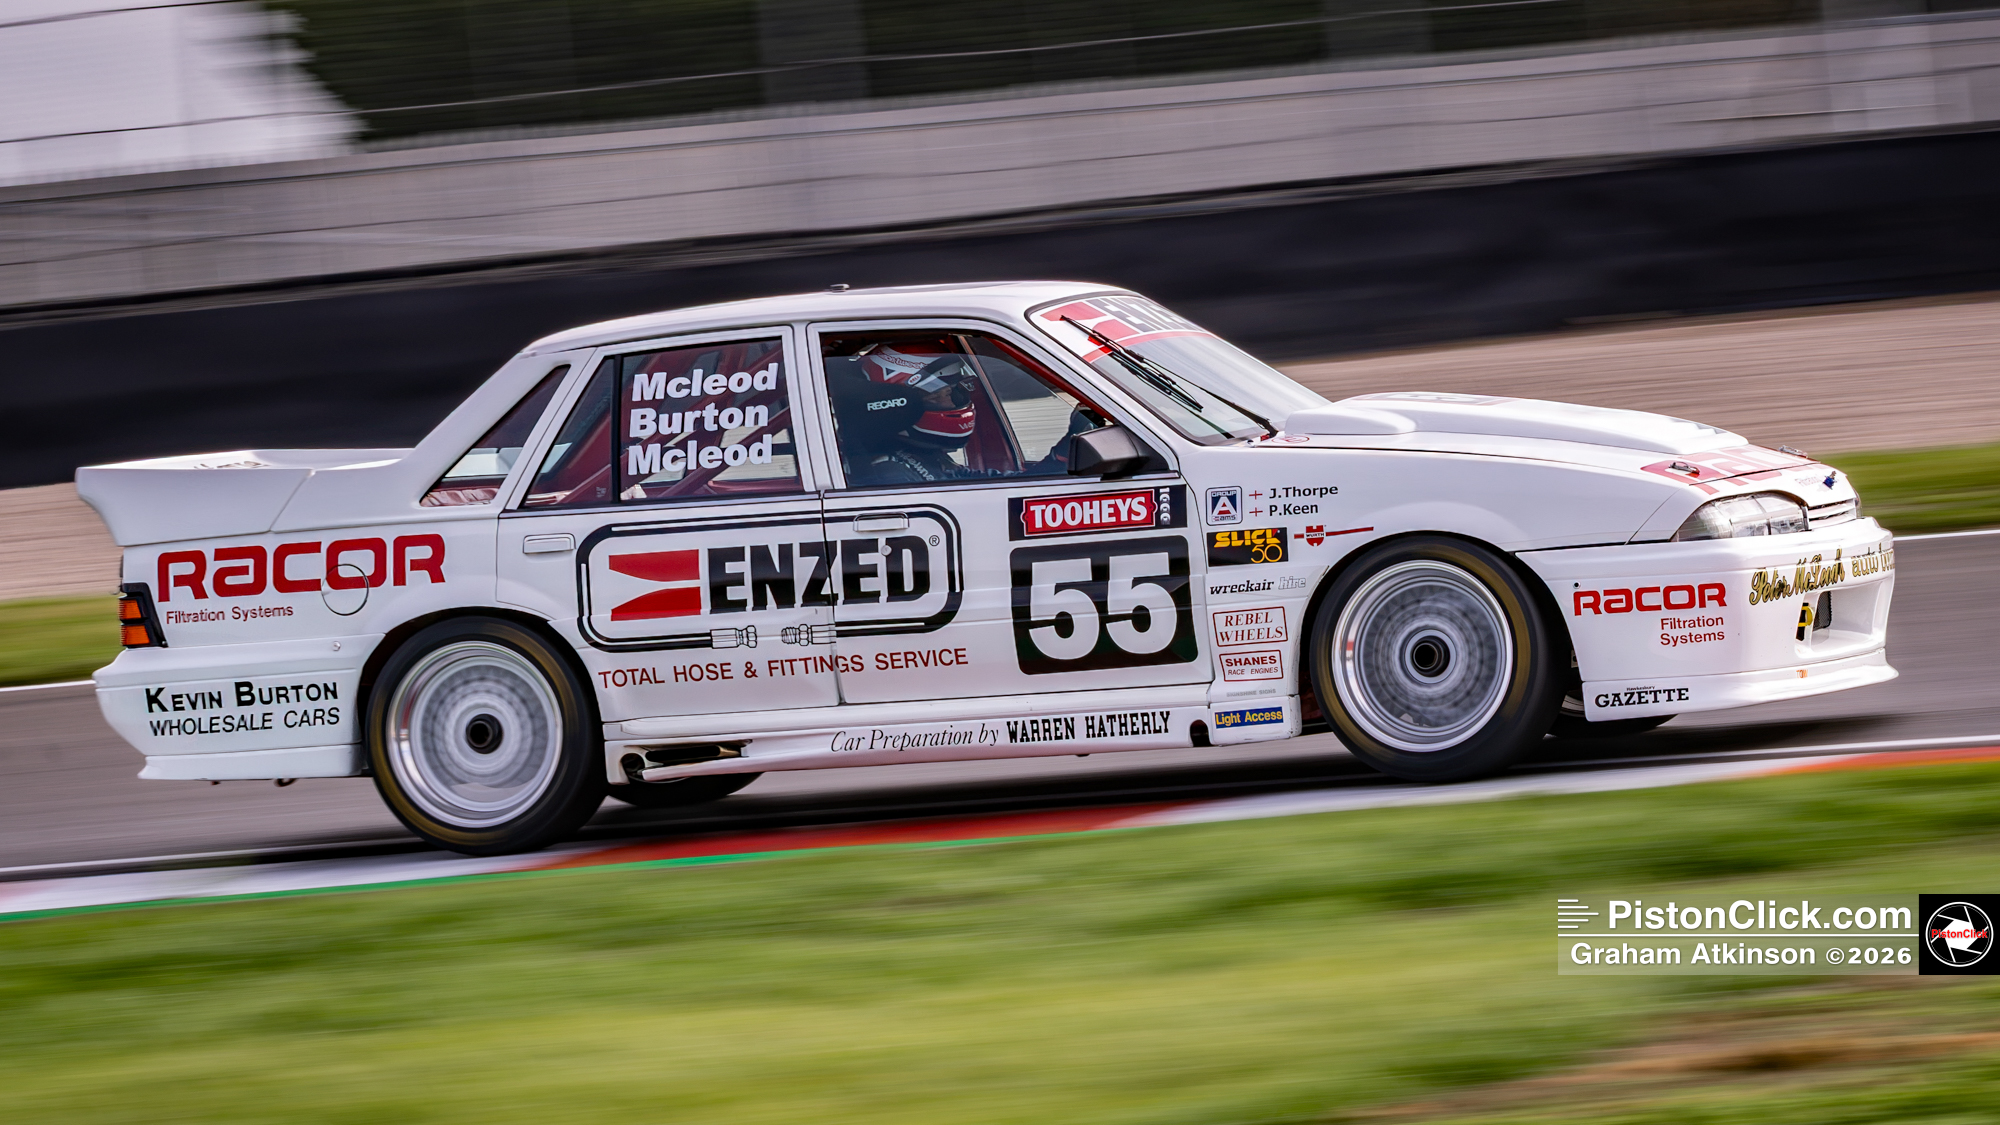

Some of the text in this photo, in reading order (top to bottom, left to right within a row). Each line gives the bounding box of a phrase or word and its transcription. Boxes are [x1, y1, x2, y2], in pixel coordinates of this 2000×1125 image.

[631, 363, 778, 401] Mcleod
[867, 397, 907, 411] RECARO
[629, 402, 768, 438] Burton
[628, 435, 772, 475] Mcleod
[1269, 485, 1339, 501] J.Thorpe
[1030, 496, 1147, 528] TOOHEYS
[1269, 503, 1318, 516] P.Keen
[1213, 528, 1281, 548] SLICK
[1250, 544, 1282, 563] 50
[157, 533, 445, 602] RACOR
[708, 535, 930, 614] ENZED
[1210, 576, 1306, 595] wreckair hire
[1749, 567, 1792, 605] Peter
[1029, 552, 1177, 660] 55
[1573, 582, 1727, 616] RACOR
[166, 606, 294, 624] Filtration Systems
[1224, 612, 1273, 627] REBEL
[1660, 614, 1724, 630] Filtration
[1219, 626, 1283, 642] WHEELS
[1660, 631, 1725, 647] Systems
[598, 648, 968, 689] TOTAL HOSE & FITTINGS SERVICE
[1225, 655, 1277, 667] SHANES
[1250, 667, 1278, 675] ENGINES
[1796, 669, 1808, 678] TOW
[1595, 688, 1689, 708] GAZETTE
[150, 707, 340, 736] WHOLESALE CARS
[1215, 711, 1283, 726] Light Access
[830, 711, 1171, 752] Car Preparation by WARREN HATHERLY
